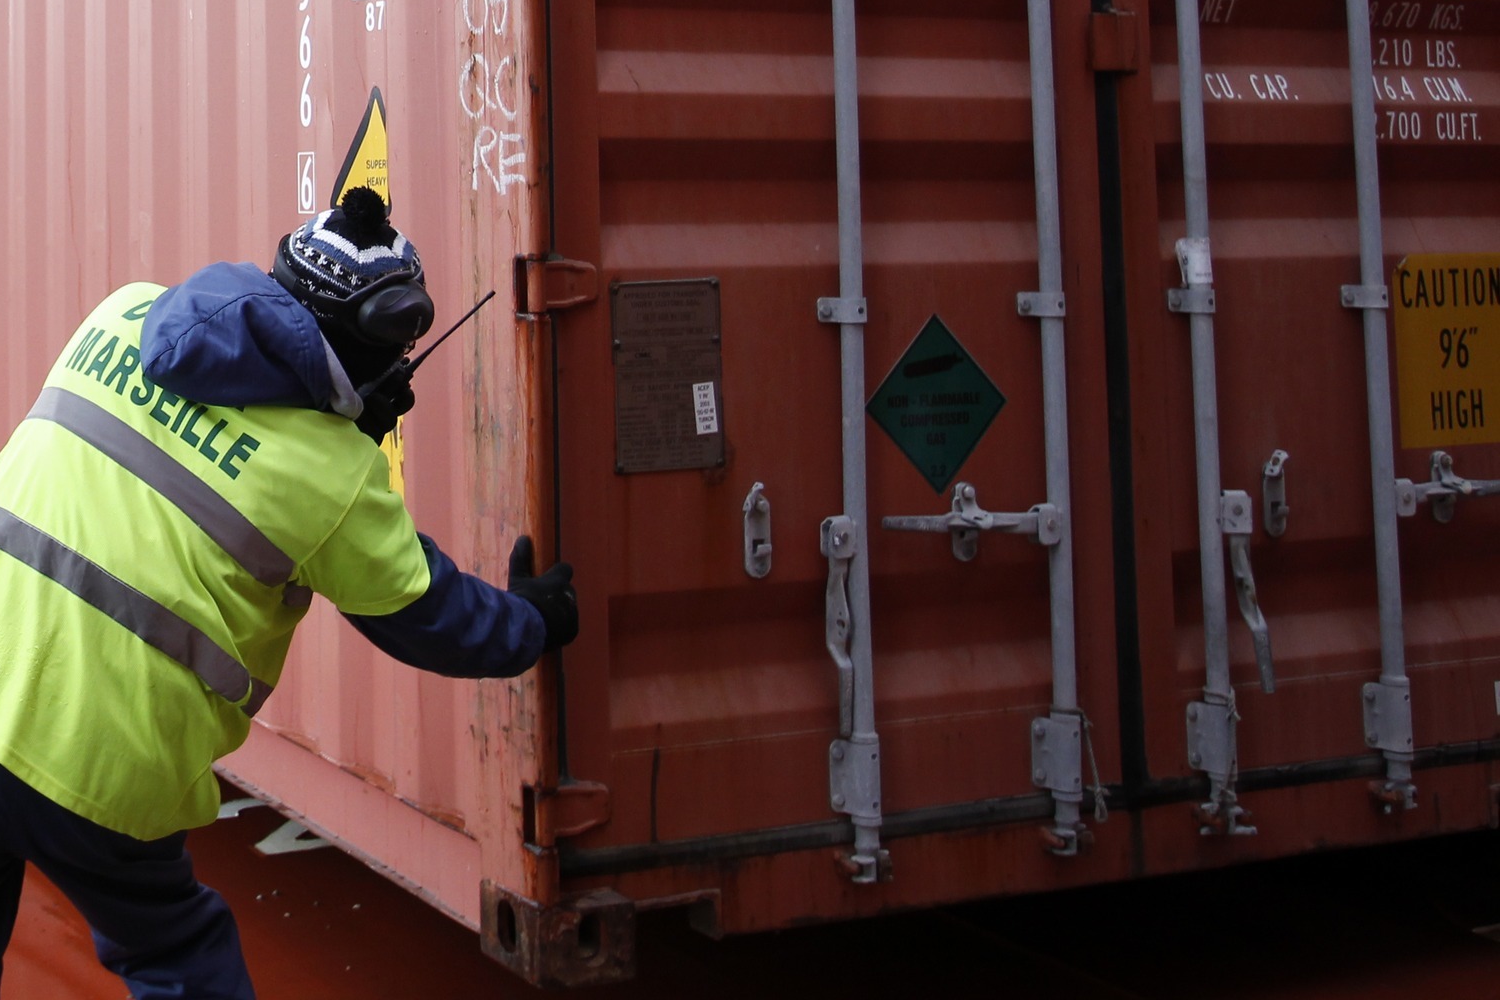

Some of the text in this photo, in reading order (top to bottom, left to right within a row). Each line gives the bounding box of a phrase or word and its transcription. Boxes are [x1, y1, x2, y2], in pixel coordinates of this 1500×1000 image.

[365, 1, 386, 31] 87
[1426, 40, 1462, 69] LBS.
[1204, 73, 1300, 100] CU. CAP.
[366, 159, 387, 170] SUPER
[300, 156, 312, 211] 6
[366, 176, 387, 187] HEAVY
[1400, 266, 1500, 309] CAUTION
[65, 327, 261, 481] MARSEILLE
[1430, 388, 1485, 431] HIGH
